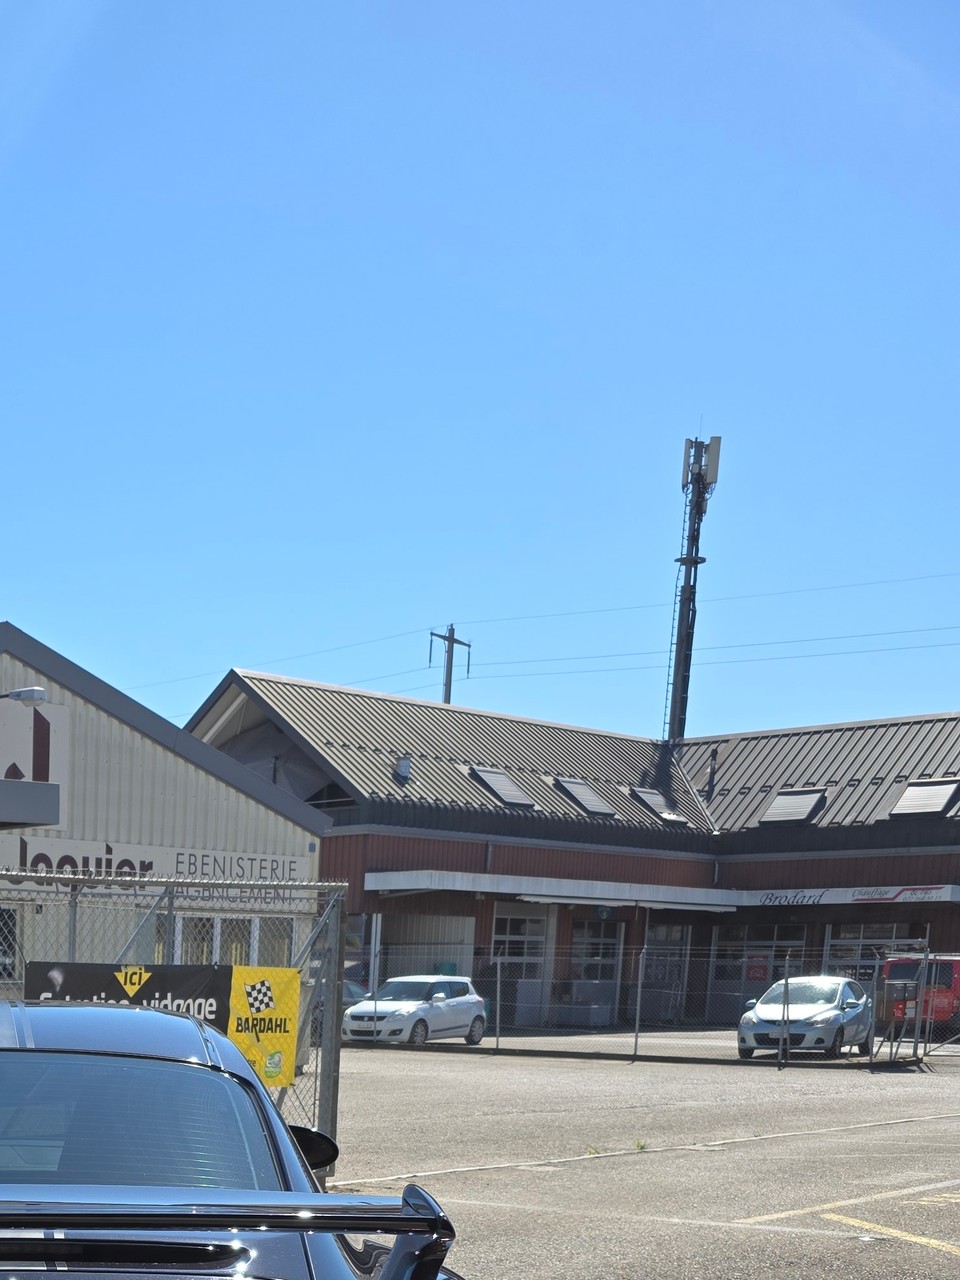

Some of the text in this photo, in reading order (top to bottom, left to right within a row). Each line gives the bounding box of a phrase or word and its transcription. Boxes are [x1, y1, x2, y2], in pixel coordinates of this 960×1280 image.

[175, 852, 297, 881] EBENISTERIE
[759, 889, 830, 905] Brodard
[235, 1016, 290, 1034] BARDAHL
